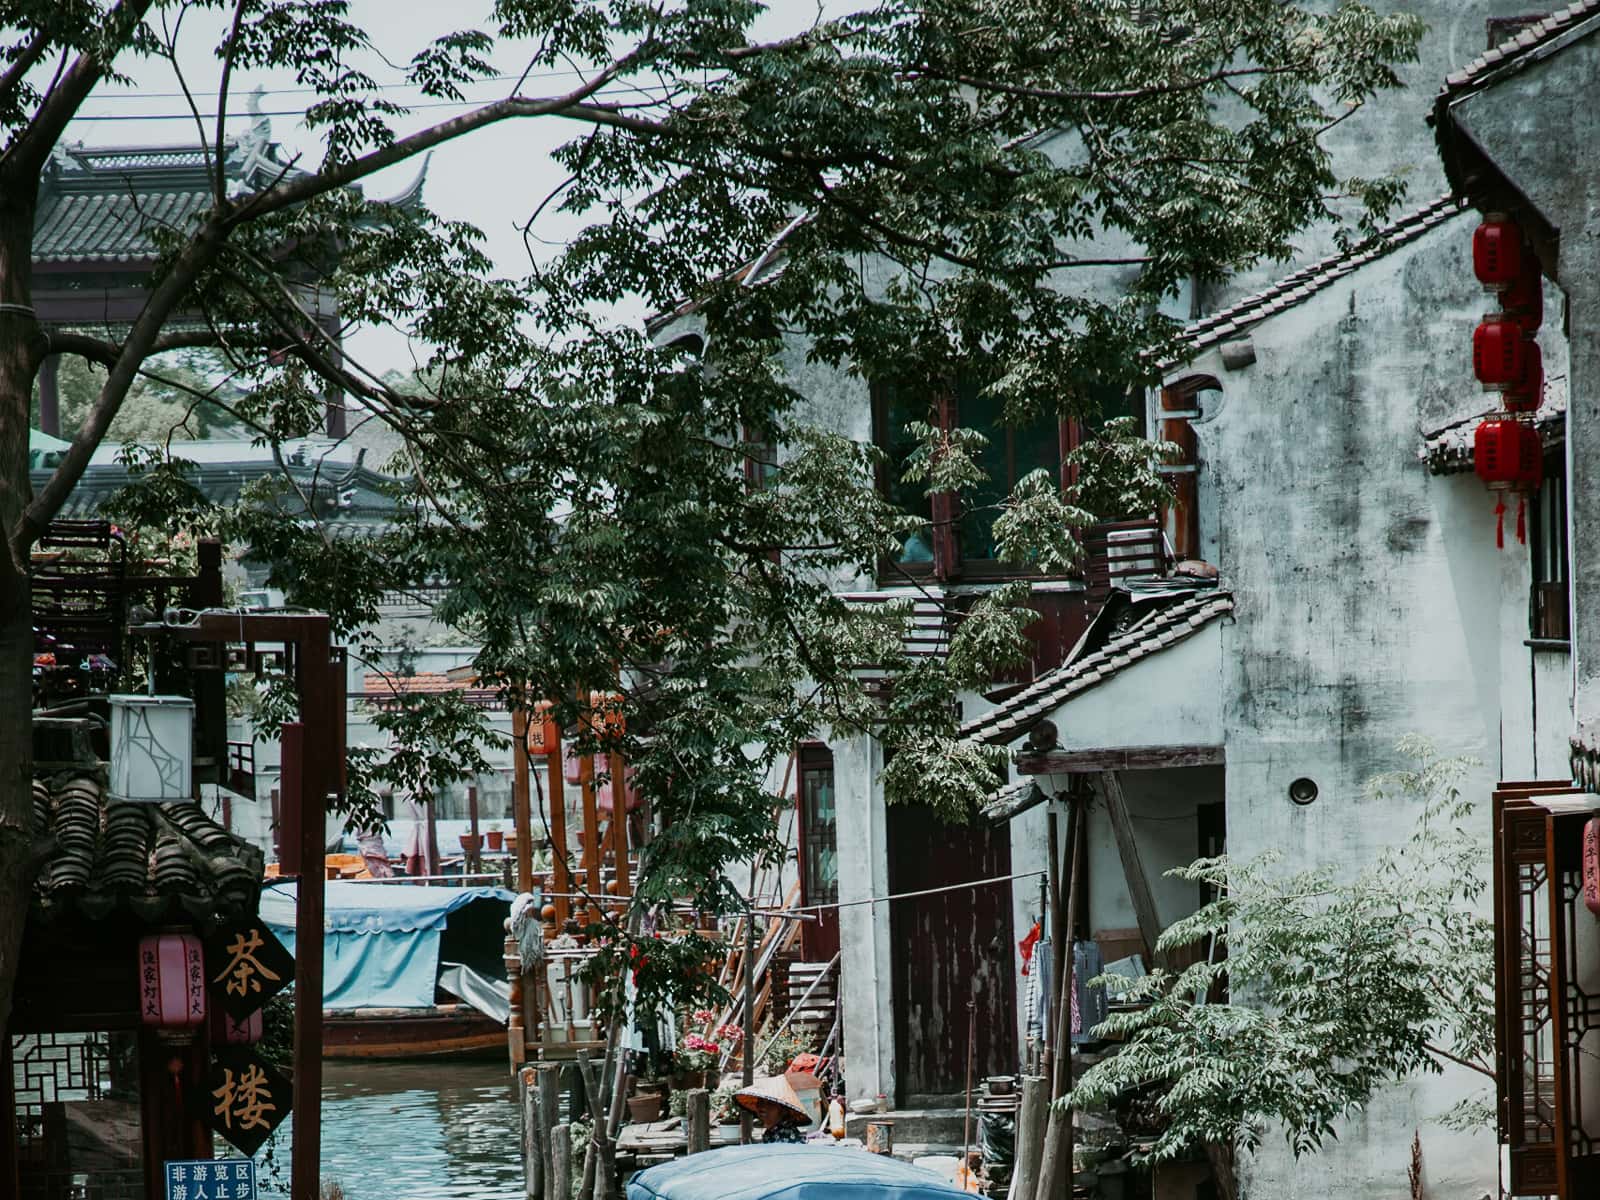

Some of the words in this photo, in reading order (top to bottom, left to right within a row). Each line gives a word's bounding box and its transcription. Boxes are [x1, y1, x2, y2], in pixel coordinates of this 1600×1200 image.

[212, 928, 280, 997] 茶
[211, 1063, 277, 1130] 楼
[171, 1164, 249, 1182] 非游览区
[172, 1182, 250, 1200] 游人止步
